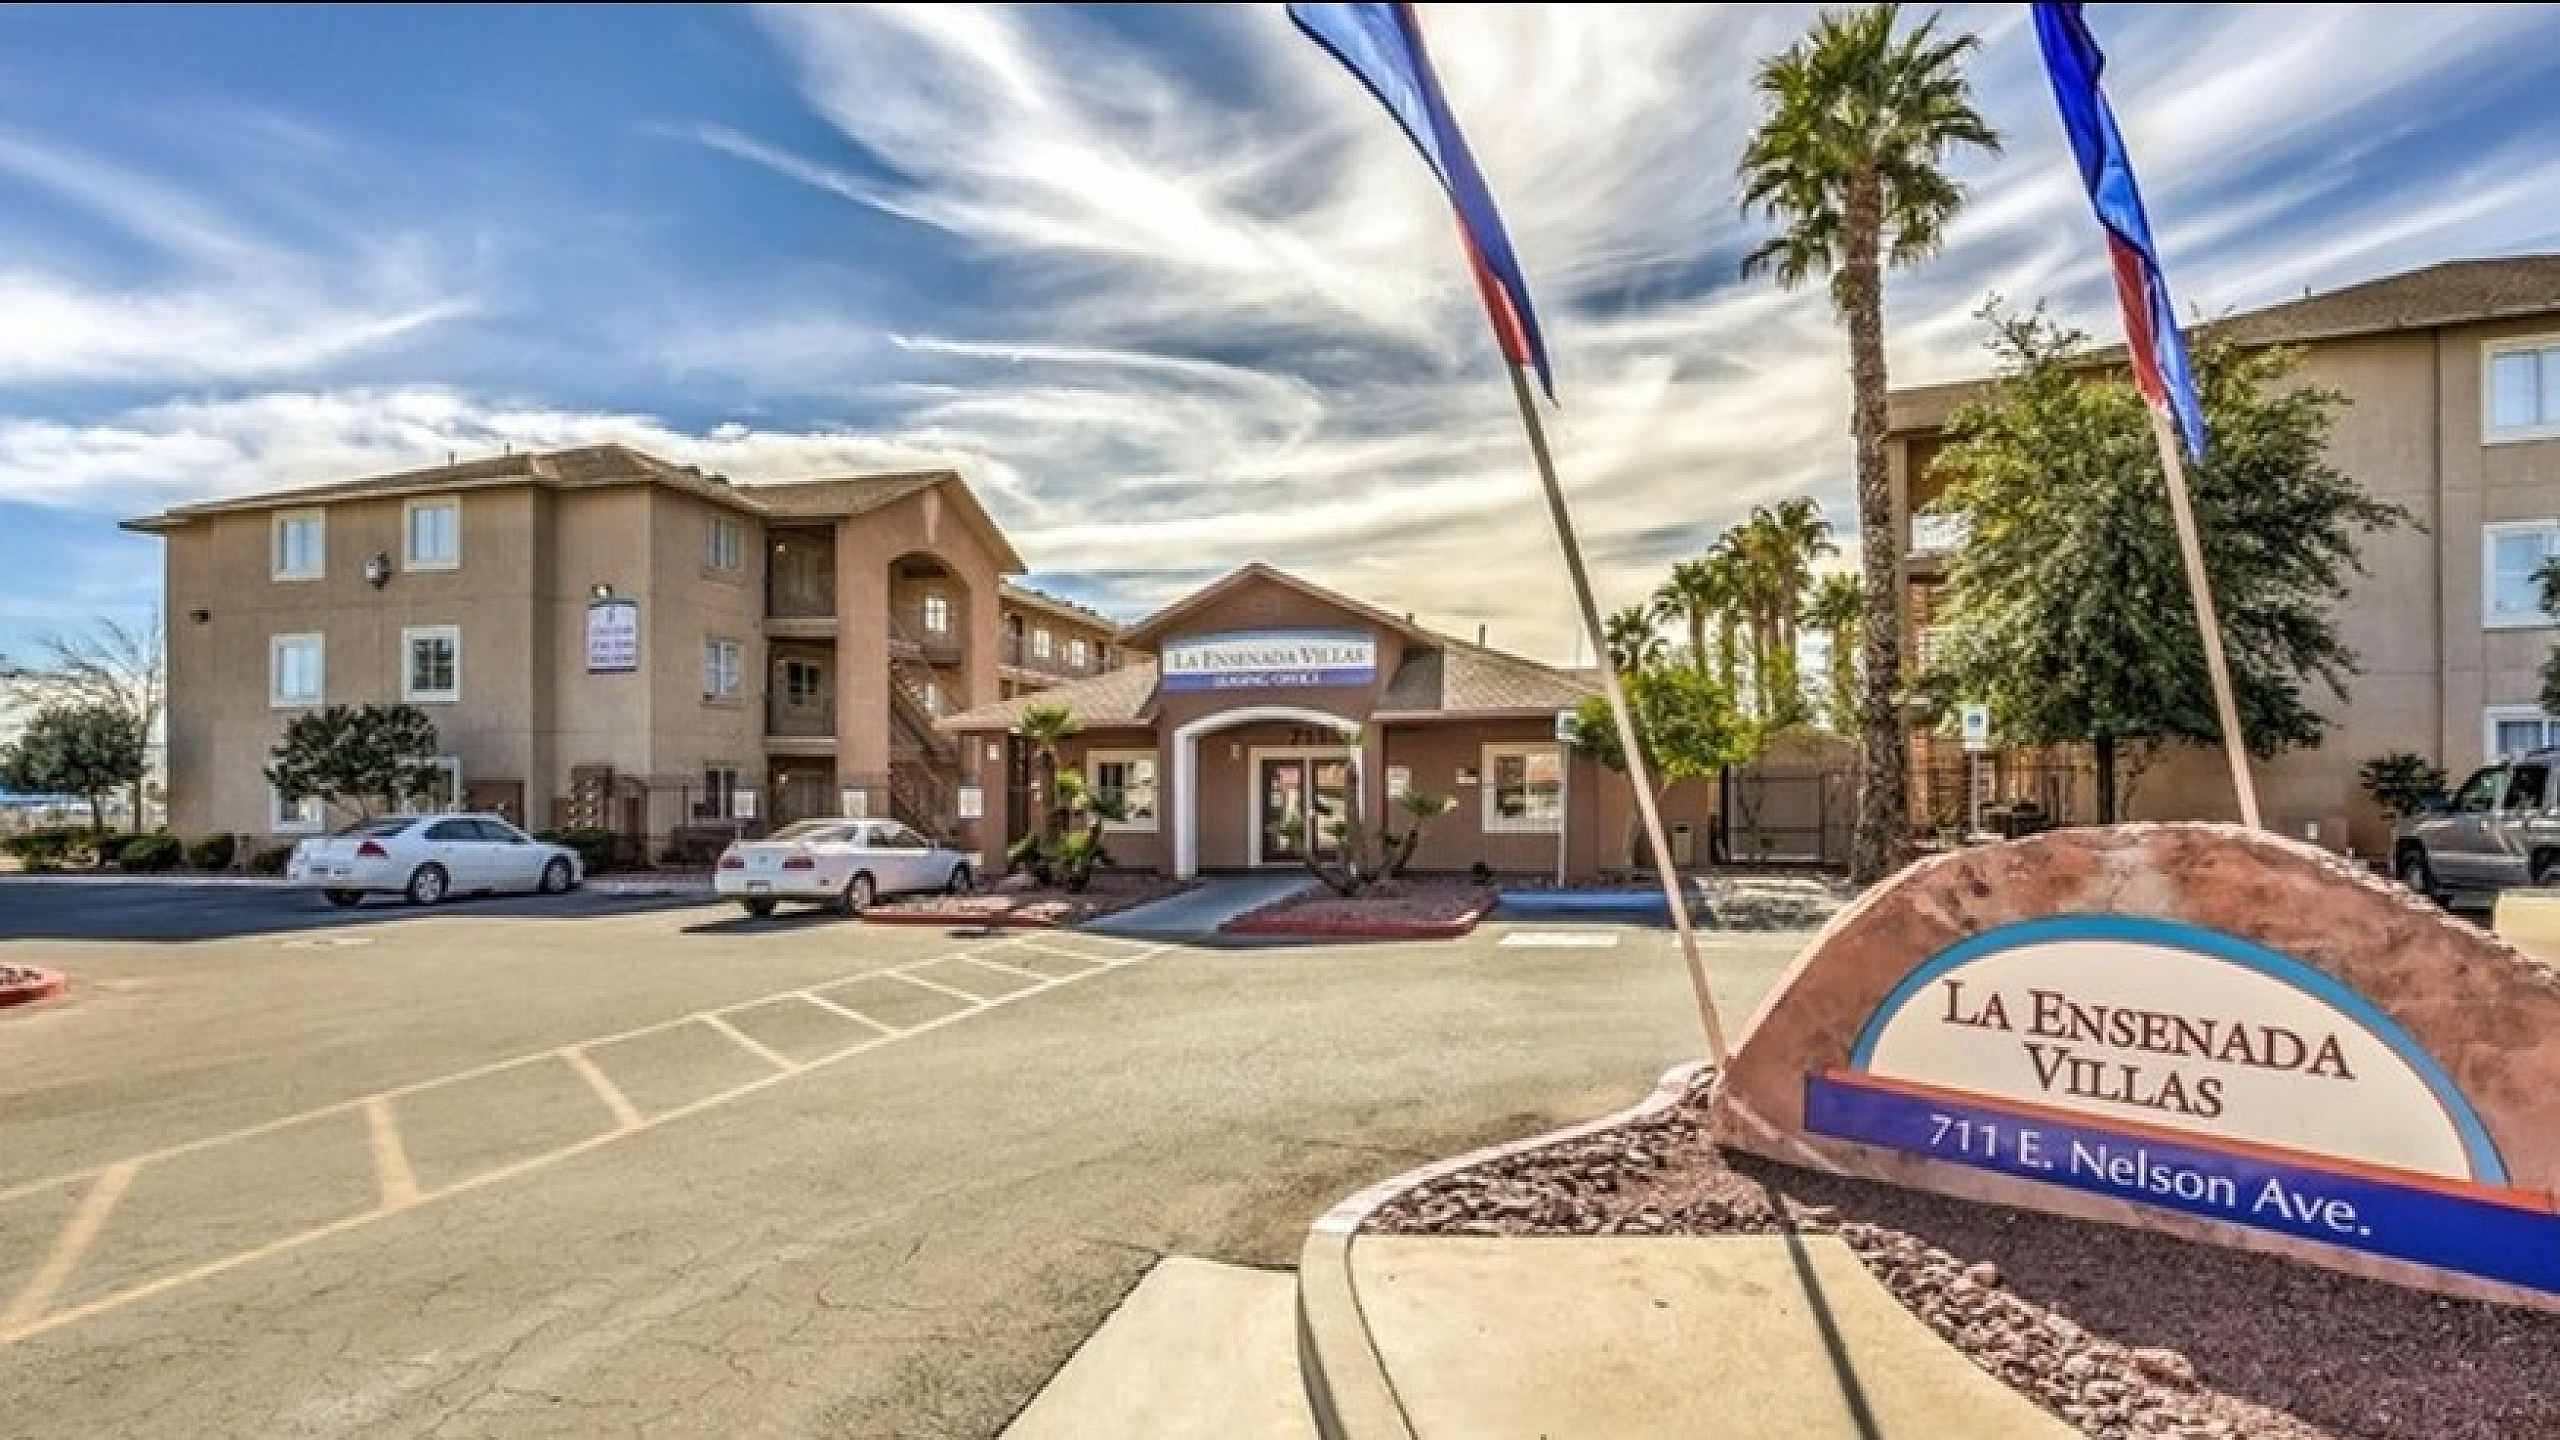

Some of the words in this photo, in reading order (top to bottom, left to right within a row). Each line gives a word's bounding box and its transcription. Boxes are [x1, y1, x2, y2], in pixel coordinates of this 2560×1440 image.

[1173, 652, 1200, 670] LA
[1203, 649, 1297, 668] ENSENADA
[1299, 646, 1365, 665] VILLAS
[1943, 978, 2011, 1032] LA
[2027, 986, 2356, 1081] ENSENADA
[2023, 1041, 2223, 1119] VILLAS
[1929, 1113, 1998, 1157] 711
[2017, 1128, 2053, 1171] E.
[2070, 1140, 2236, 1207] Nelson
[2252, 1177, 2372, 1236] Ave.
